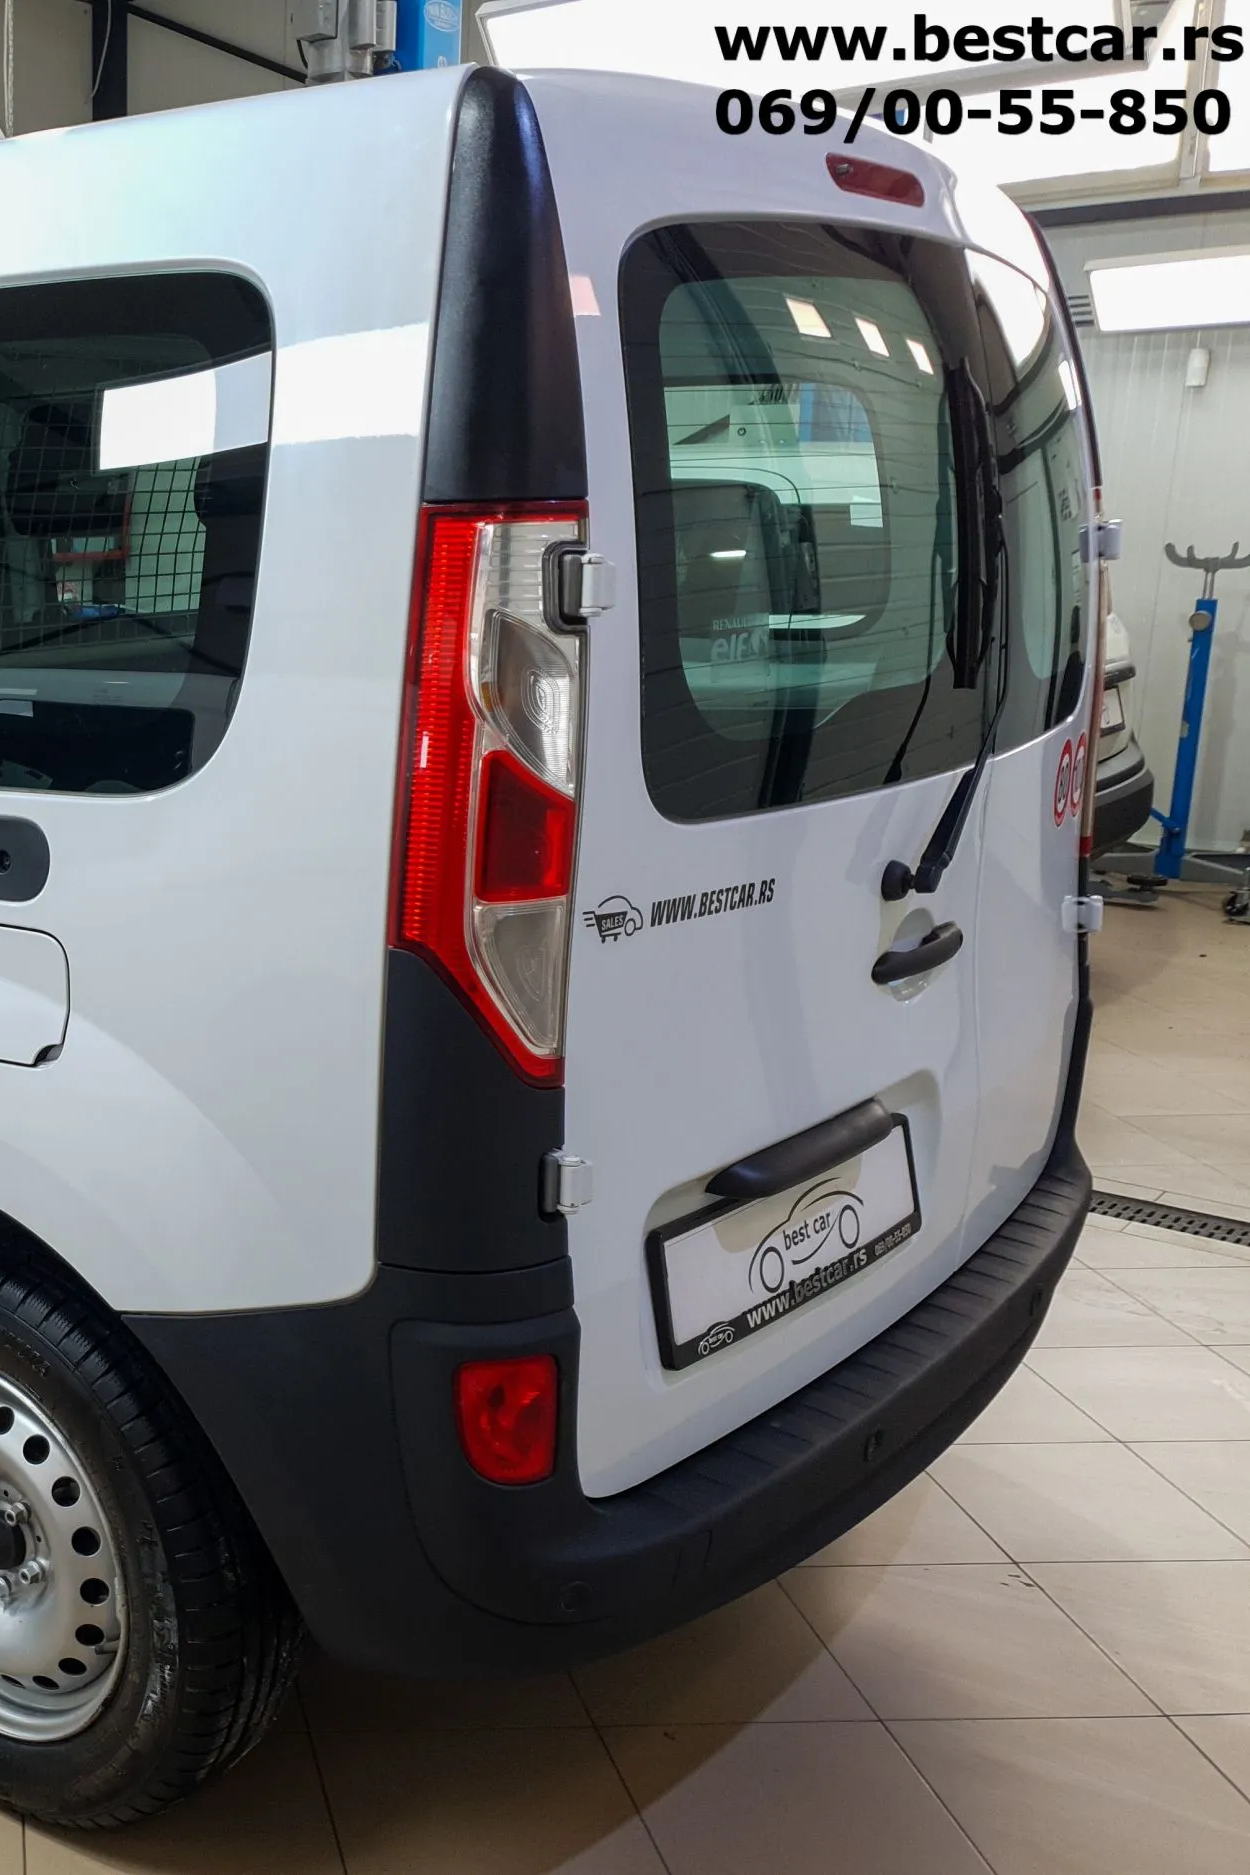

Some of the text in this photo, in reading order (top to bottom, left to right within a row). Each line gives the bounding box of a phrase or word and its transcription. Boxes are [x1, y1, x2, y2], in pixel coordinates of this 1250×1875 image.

[601, 914, 625, 932] SALES
[650, 877, 776, 928] WWW.BESTCAR.RS
[783, 1211, 831, 1251] best car
[746, 1247, 867, 1329] www.bestcar.rs
